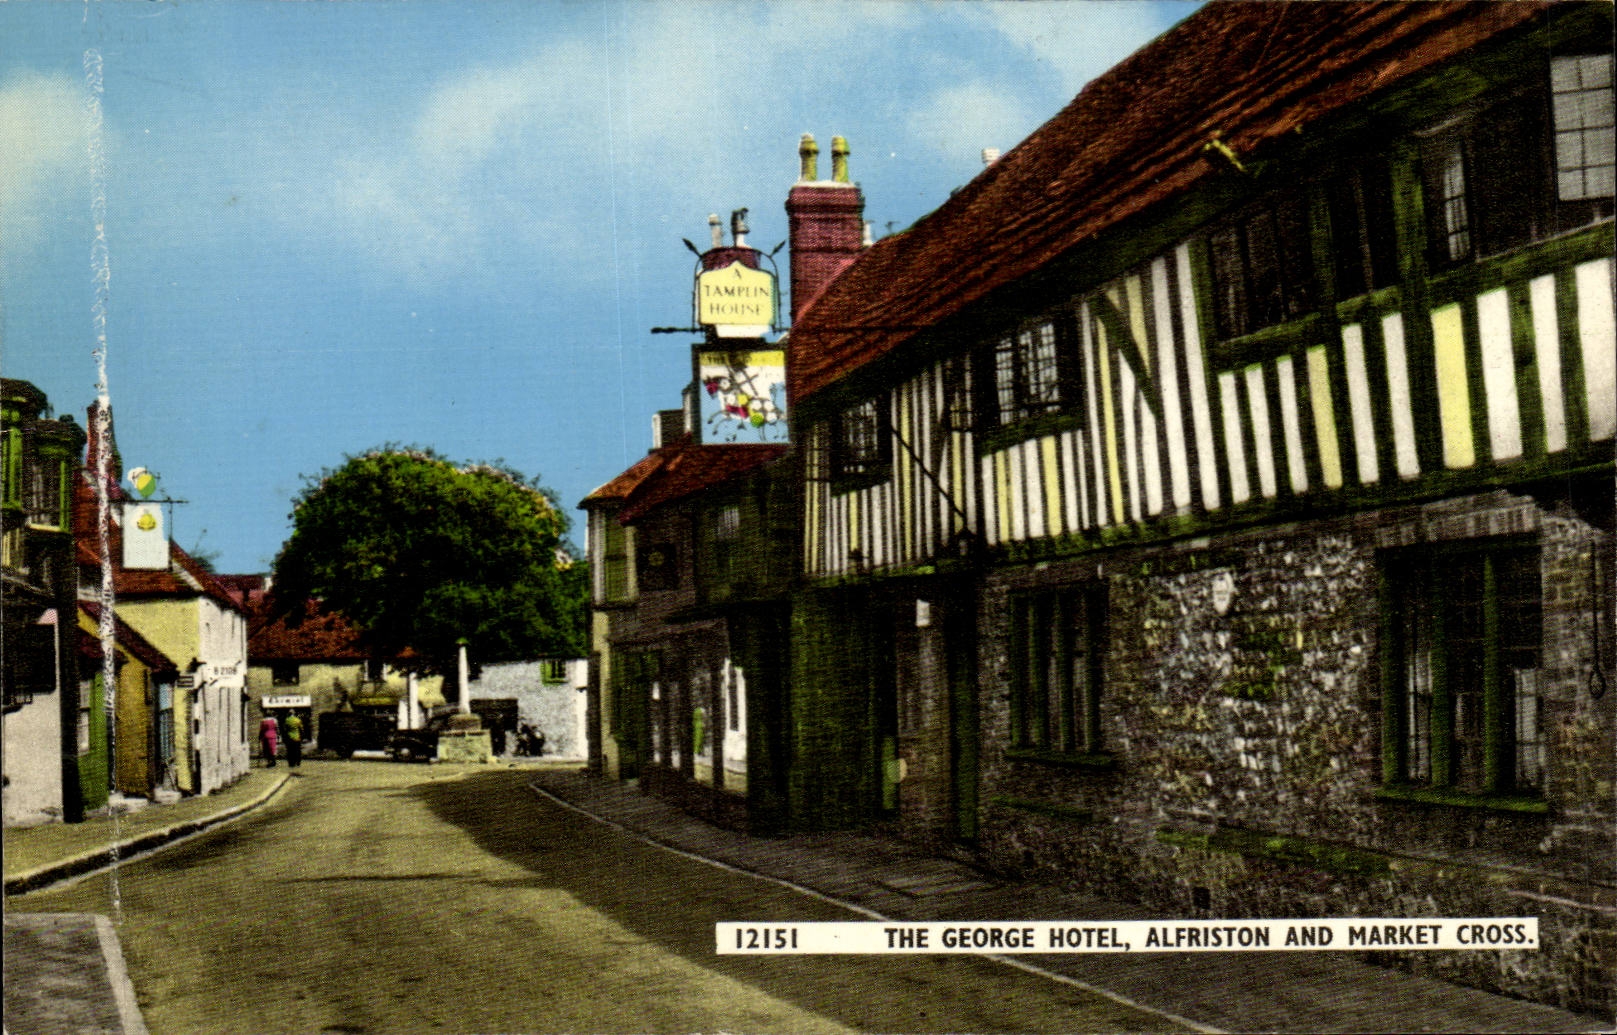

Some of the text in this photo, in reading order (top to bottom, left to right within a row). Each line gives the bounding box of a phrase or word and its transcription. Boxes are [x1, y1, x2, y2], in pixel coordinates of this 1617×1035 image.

[734, 268, 742, 279] A
[704, 285, 769, 297] TAMPLIN
[710, 303, 763, 316] HOUSE
